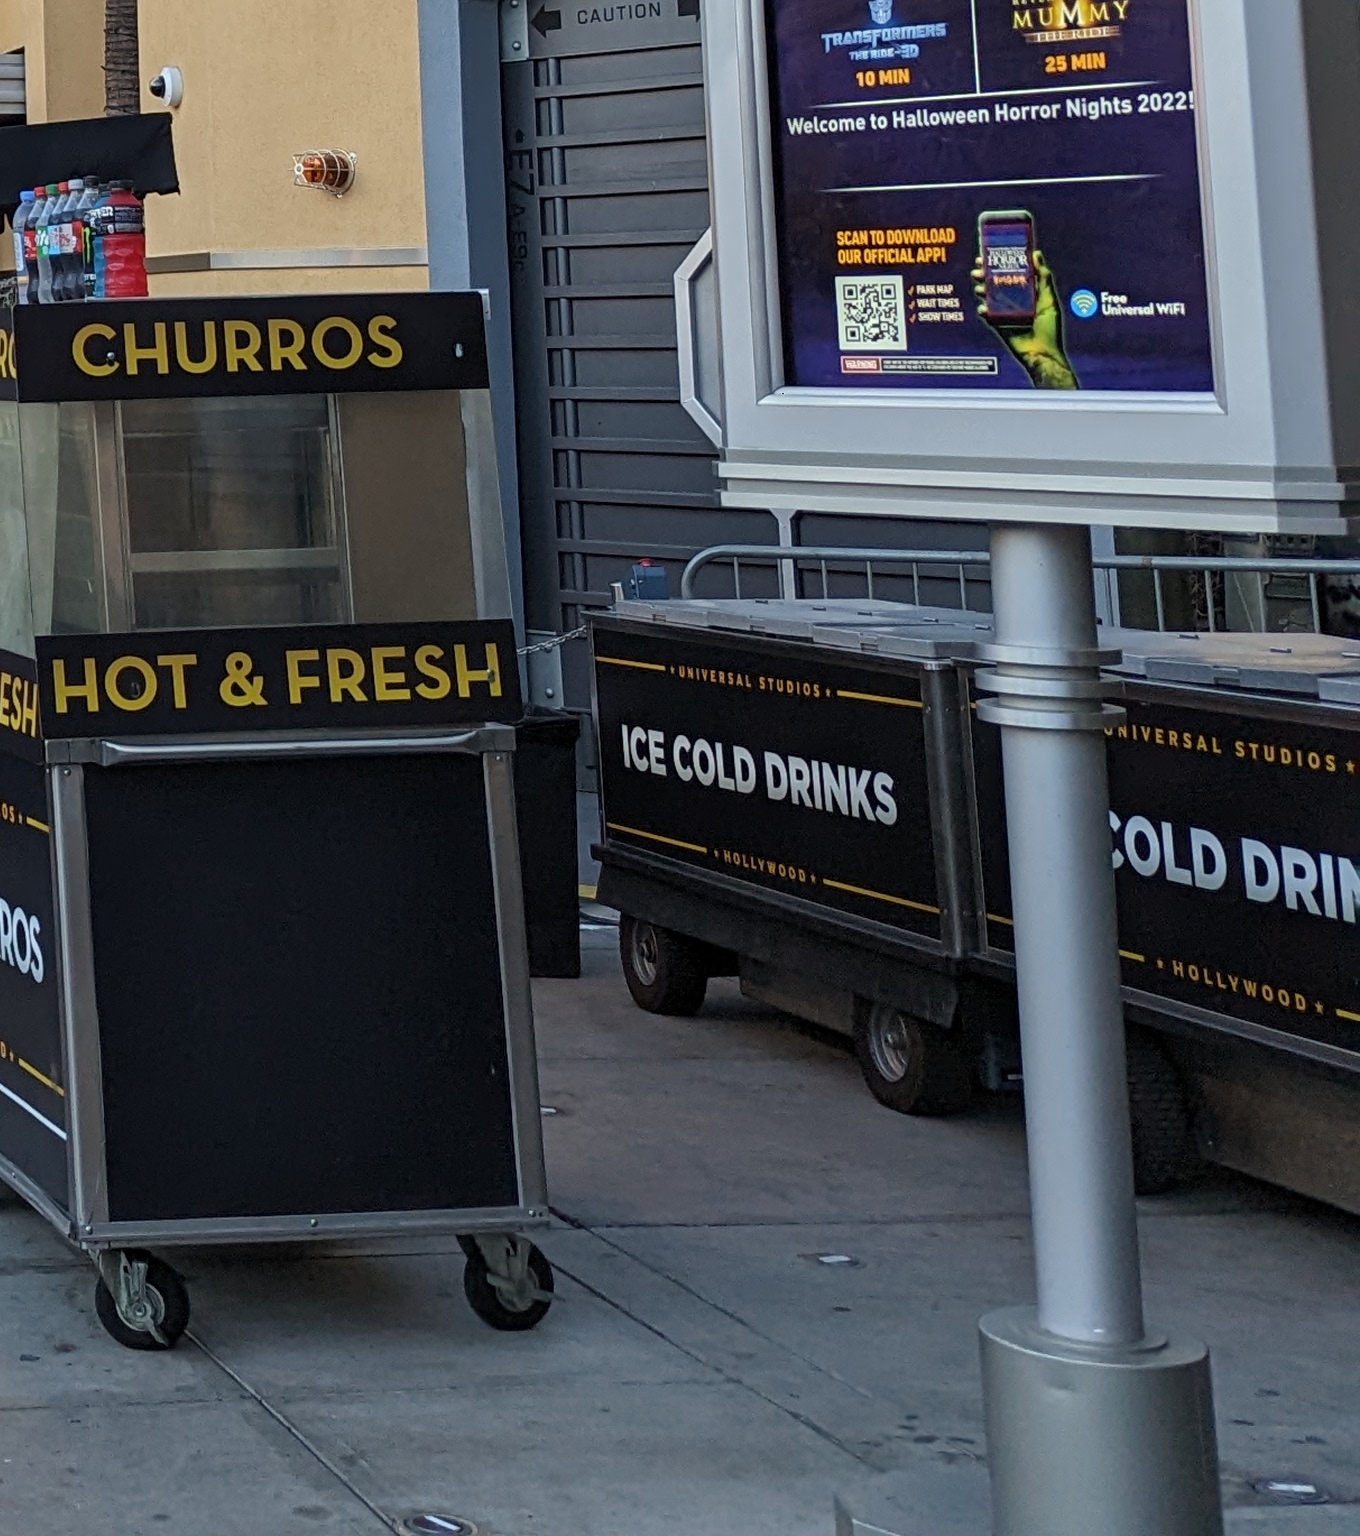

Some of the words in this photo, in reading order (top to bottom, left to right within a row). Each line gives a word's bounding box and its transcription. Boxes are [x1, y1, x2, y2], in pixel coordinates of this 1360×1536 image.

[576, 1, 661, 26] CAUTION
[821, 22, 947, 54] TRANSFORMERS
[848, 50, 869, 61] THE
[1044, 55, 1067, 73] 25
[1071, 51, 1107, 71] MIN
[855, 71, 875, 88] 10
[879, 68, 910, 85] MIN
[786, 116, 866, 136] Welcome
[870, 113, 888, 130] to
[892, 108, 990, 129] Halloween
[994, 102, 1061, 123] Horror
[1066, 96, 1133, 121] Nights
[1137, 90, 1195, 113] 2022!
[836, 230, 868, 246] SCAN
[870, 229, 885, 245] TO
[886, 227, 956, 245] DOWNLOAD
[837, 249, 862, 264] OUR
[863, 248, 915, 264] OFFICIAL
[1100, 291, 1128, 304] Free
[1101, 302, 1155, 316] Universal
[72, 315, 404, 378] CHURROS
[52, 653, 197, 714] HOT
[219, 651, 268, 707] &
[284, 642, 504, 705] FRESH
[678, 665, 752, 689] UNIVERSAL
[759, 675, 821, 698] STUDIOS
[1234, 740, 1336, 773] STUDIOS
[622, 724, 667, 777] ICE
[673, 733, 757, 795] COLD
[764, 750, 898, 826] DRINKS
[723, 849, 806, 883] HOLLYWOOD
[1172, 959, 1307, 1011] HOLLYWOOD
